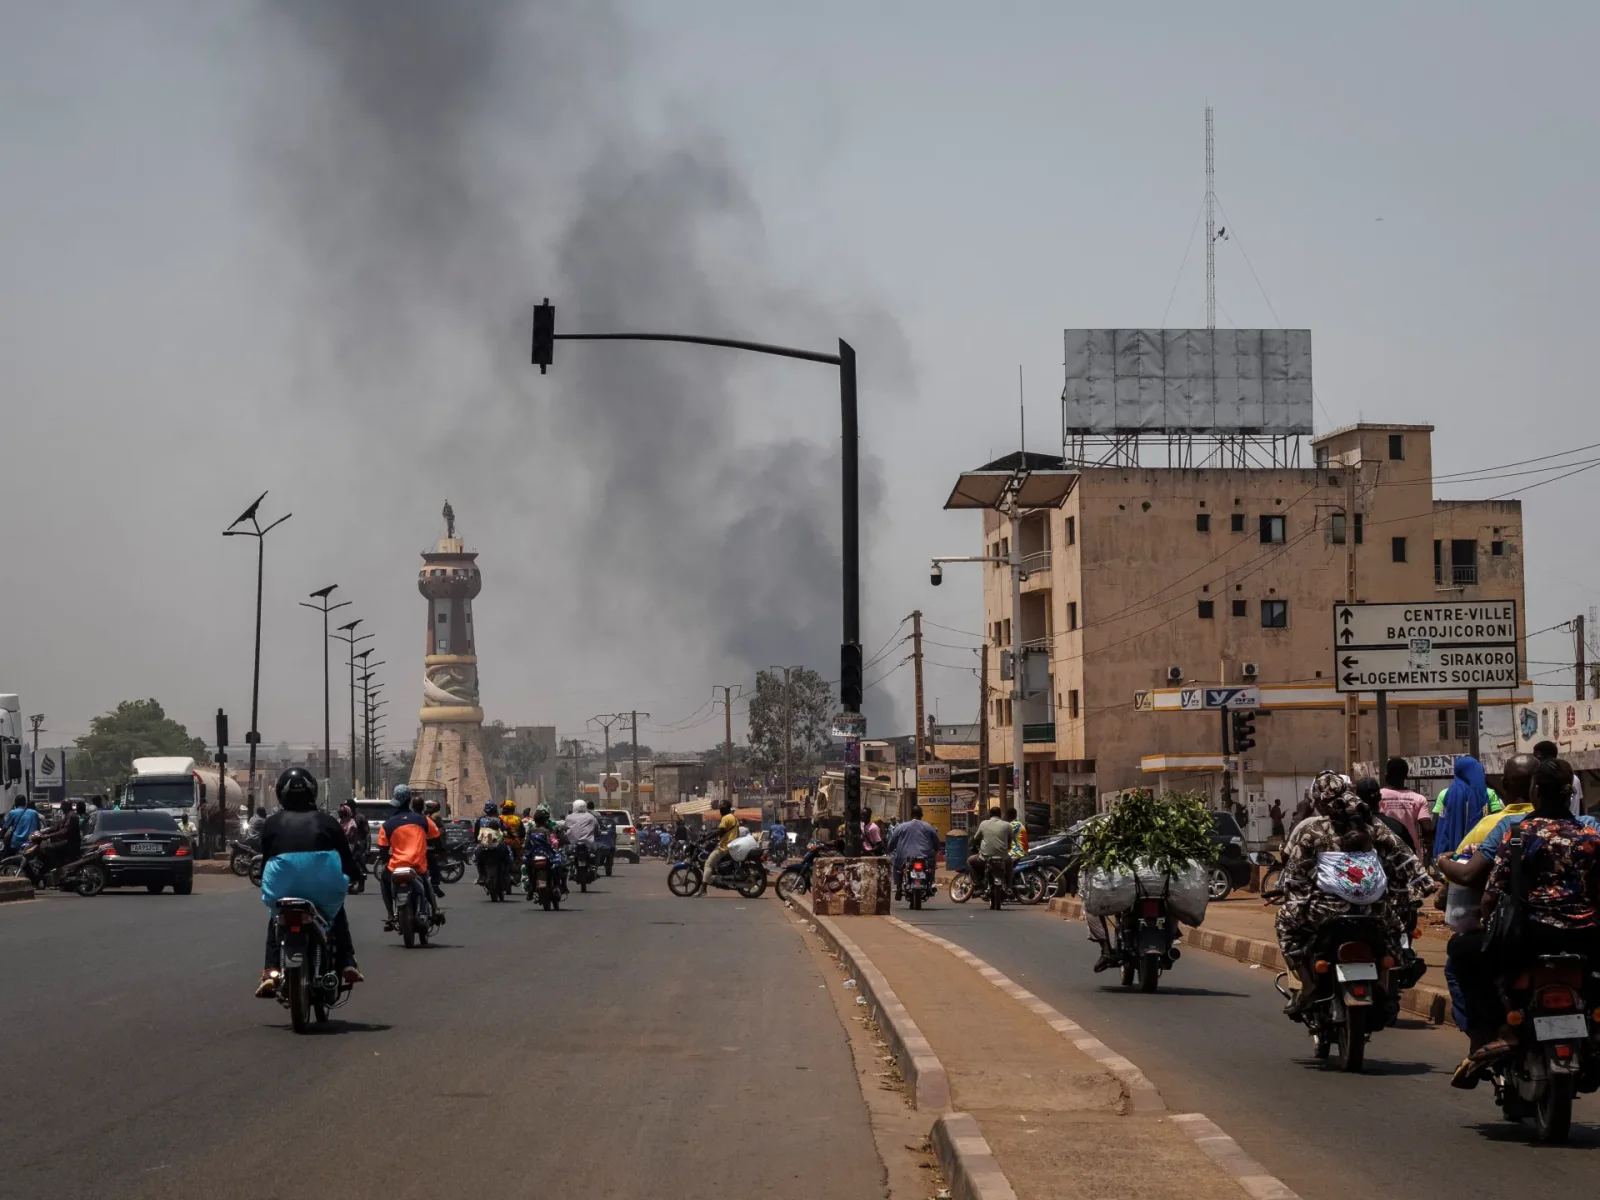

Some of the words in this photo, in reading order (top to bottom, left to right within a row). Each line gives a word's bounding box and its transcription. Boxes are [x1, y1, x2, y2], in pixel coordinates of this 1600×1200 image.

[1404, 607, 1512, 622] CENTRE-VILLE
[1387, 624, 1513, 639] BACODJICORONI
[1440, 652, 1514, 666] SIRAKORO
[1360, 671, 1448, 685] LOGEMENTS
[1451, 669, 1515, 683] SOCIAUX
[928, 767, 945, 775] BMS
[1420, 769, 1437, 777] AUTO
